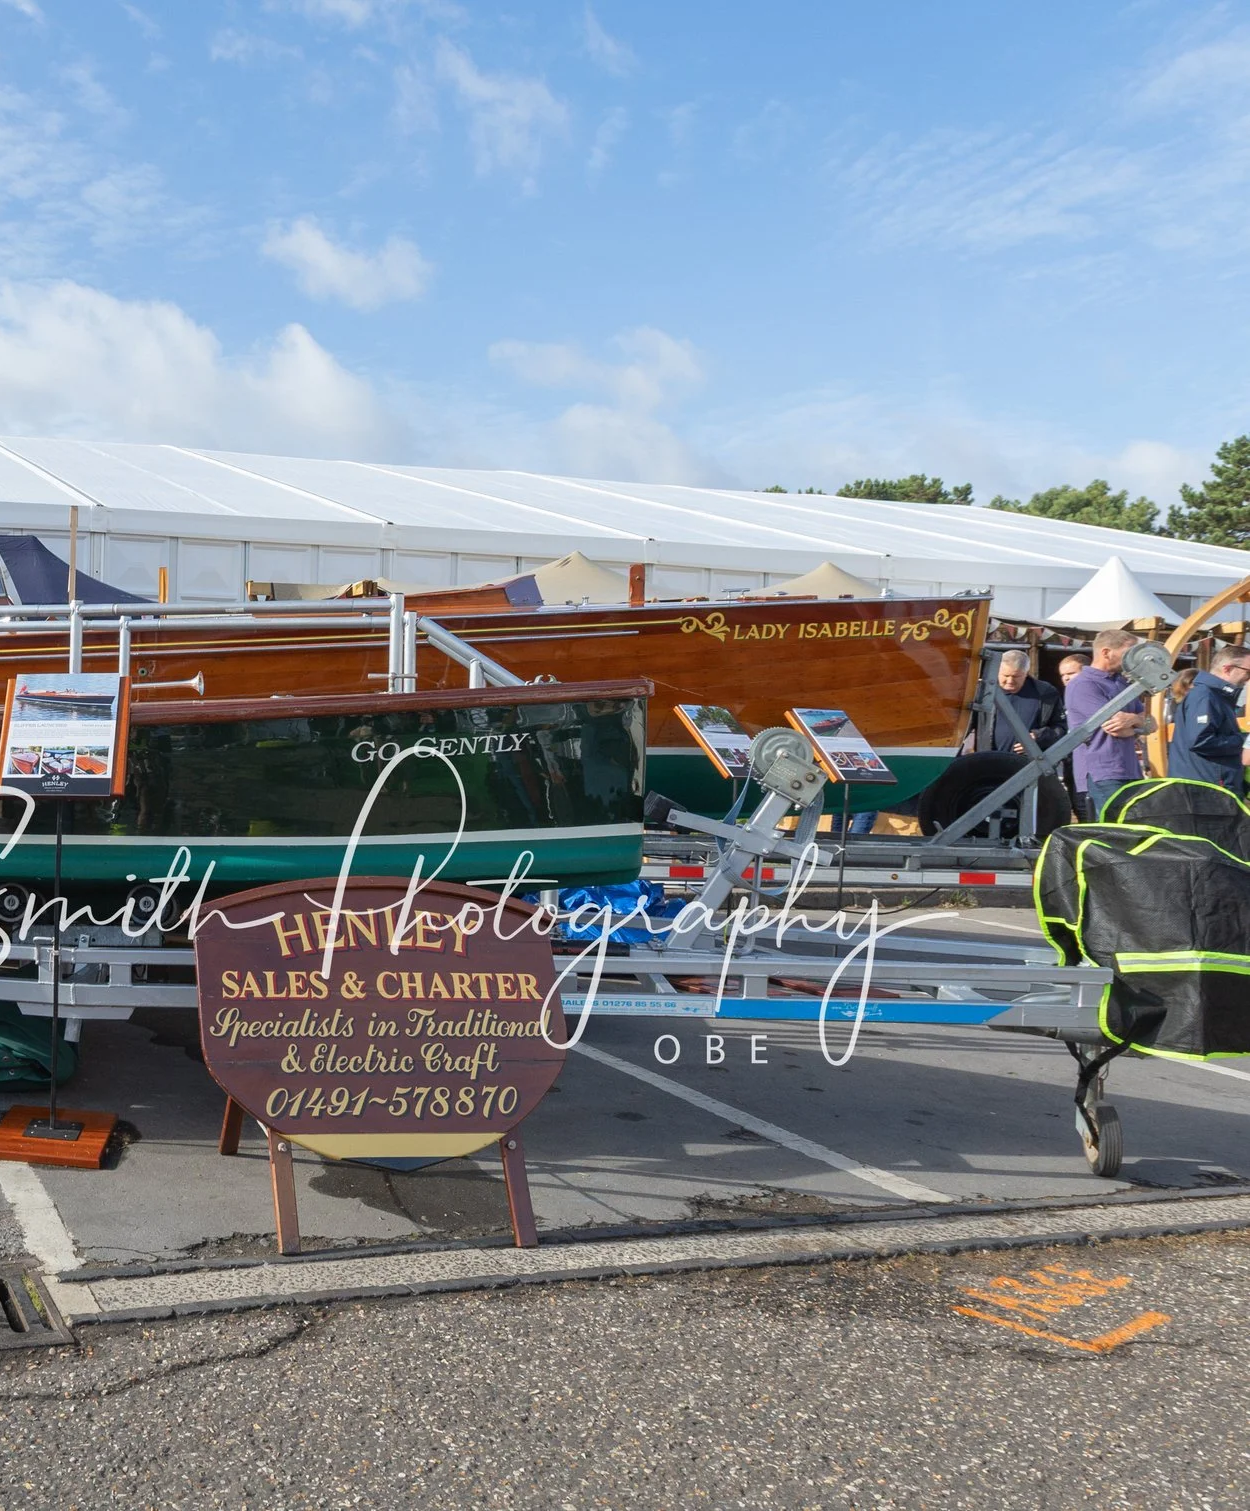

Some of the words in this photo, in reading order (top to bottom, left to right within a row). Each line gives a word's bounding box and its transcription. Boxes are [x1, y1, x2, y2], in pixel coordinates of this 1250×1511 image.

[733, 623, 791, 640] LADY
[798, 620, 897, 639] ISABELLE
[41, 780, 69, 788] HENLEY
[271, 908, 480, 957] HENLEY
[221, 970, 330, 999] SALES
[340, 971, 367, 999] &
[375, 971, 544, 1000] CHARTER
[209, 1006, 354, 1047] Specialists
[367, 1010, 399, 1038] in
[405, 1007, 553, 1038] Traditional
[280, 1043, 307, 1074] &
[310, 1042, 414, 1074] Electric
[420, 1042, 500, 1080] Craft
